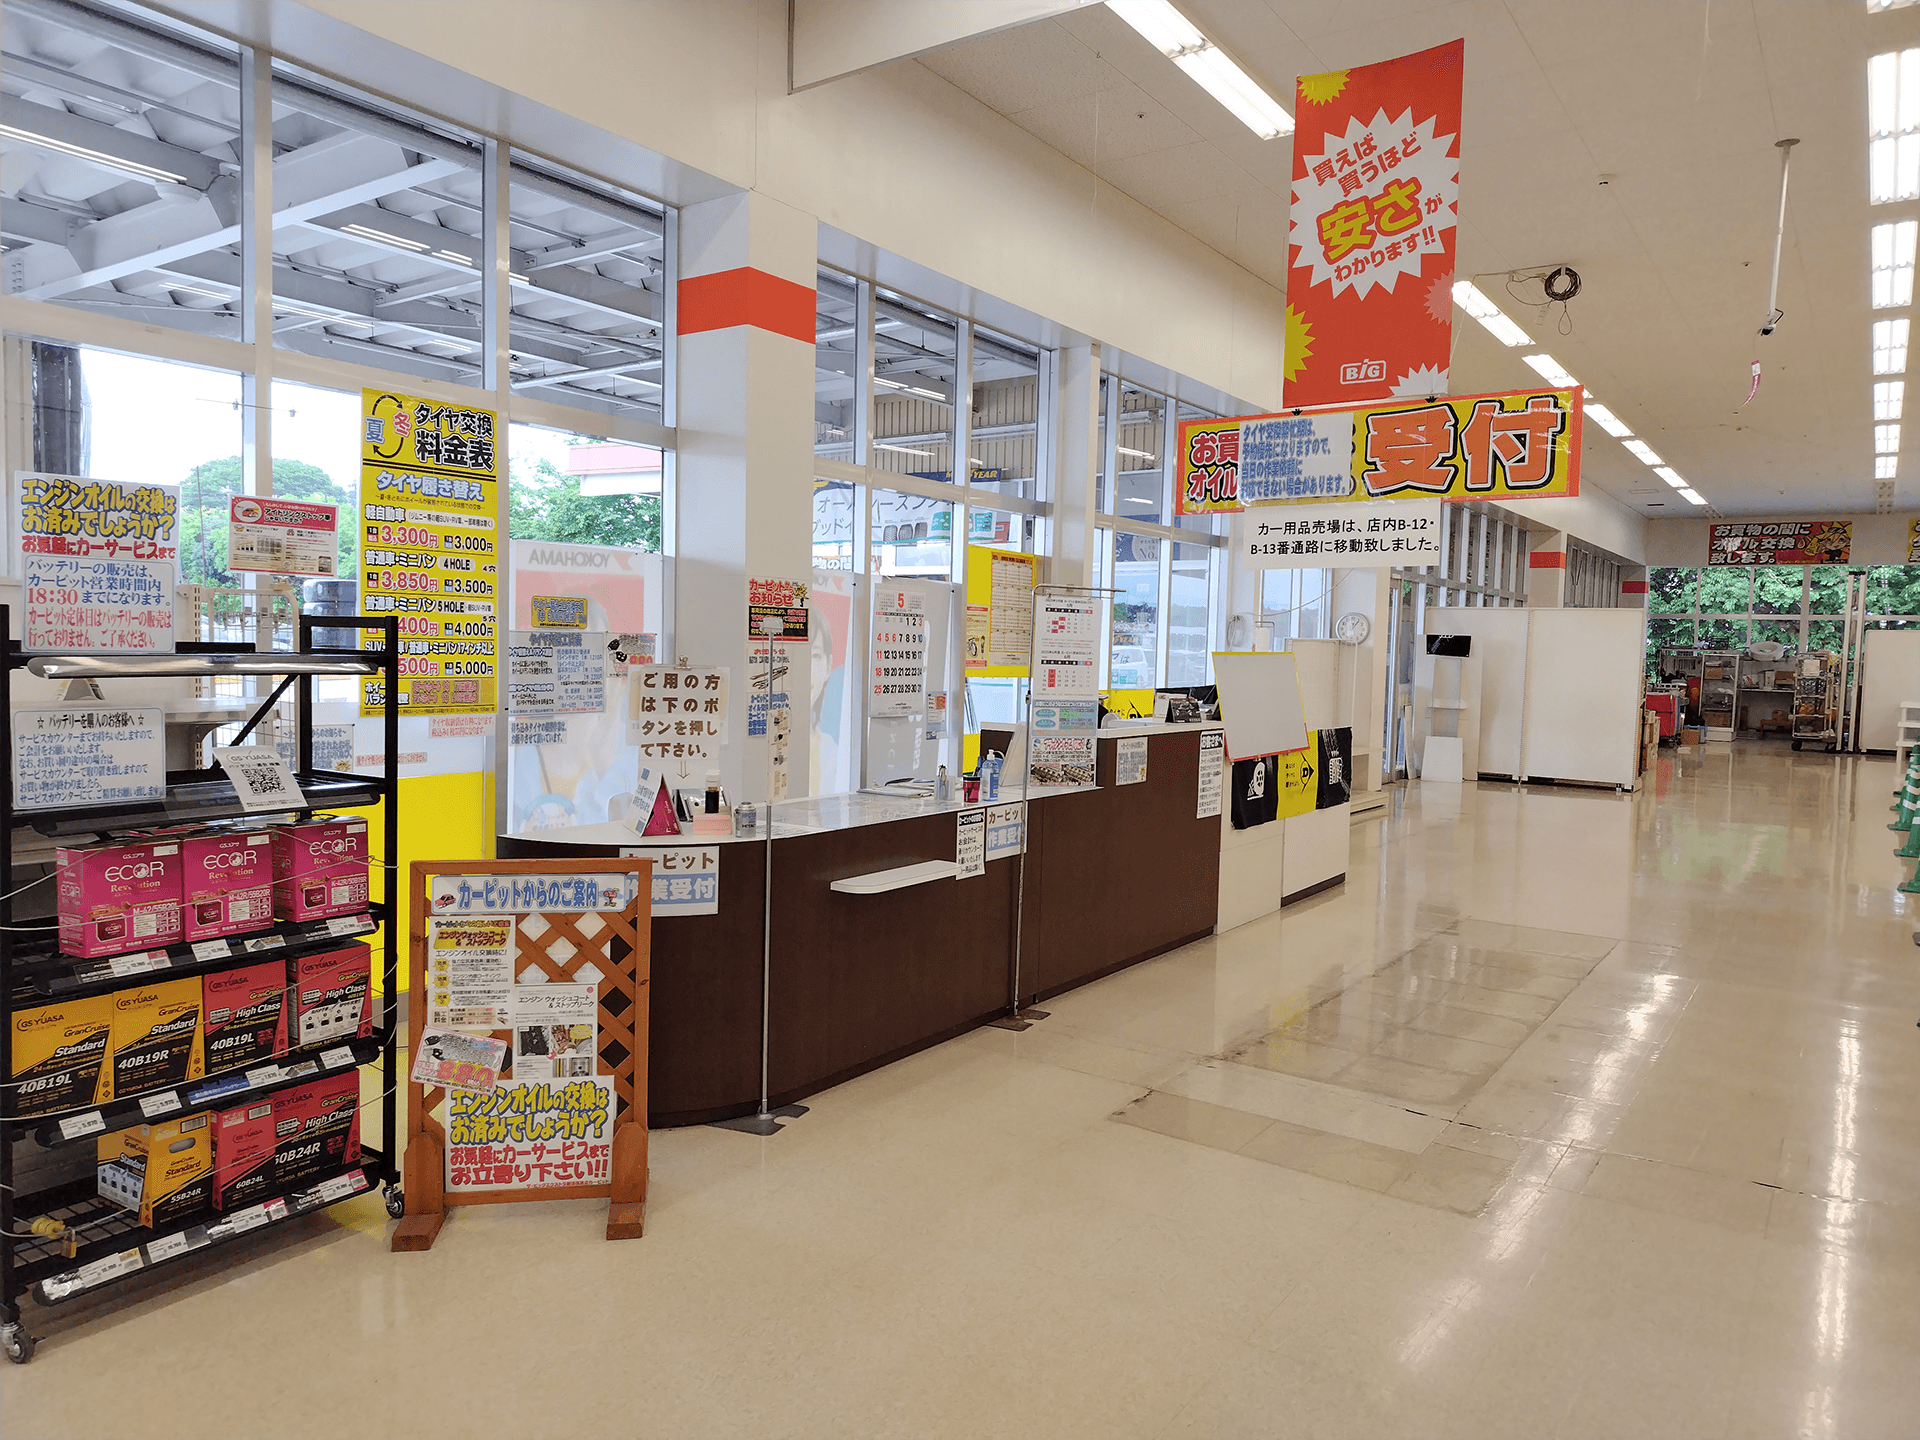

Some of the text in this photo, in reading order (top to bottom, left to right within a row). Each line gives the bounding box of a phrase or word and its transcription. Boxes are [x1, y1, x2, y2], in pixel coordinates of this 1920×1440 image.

[1312, 132, 1378, 187] 買えば
[1338, 131, 1422, 197] 買うほど
[1334, 225, 1436, 283] わかります!!
[393, 411, 412, 438] 冬
[414, 402, 494, 438] タイヤ交換
[365, 416, 385, 444] 夏
[414, 428, 495, 472] 料金表
[1242, 437, 1331, 460] 予約優先になりますので、
[1363, 395, 1565, 497] 受付
[376, 470, 485, 502] タイヤ履き替え
[1188, 467, 1239, 502] オイル
[21, 479, 176, 514] エンジンオイルの交換は
[365, 504, 406, 523] 軽自動車
[381, 525, 493, 552] 3,300円 3,000円
[1713, 523, 1812, 537] お買物の間に
[22, 535, 176, 559] お気軽にカーサービスまで
[1250, 537, 1440, 555] B-13番通路に移動致しました。
[365, 549, 436, 568] 普通車・ミニバン
[450, 559, 471, 570] HOLE
[1710, 551, 1777, 564] 致します。
[28, 559, 153, 578] バッテリーの販売は、
[28, 573, 161, 592] カーピット営業時間内
[381, 571, 493, 595] 3,850円 3,500円
[27, 587, 170, 607] 18:30 までになります。
[365, 595, 436, 612] 普通車・ミニバン
[444, 601, 465, 613] HOLE
[749, 591, 794, 606] お知らせ
[897, 593, 904, 608] 5
[28, 606, 172, 629] カーピット定休日はバッテリーの販売は
[906, 618, 922, 627] 1 2 3
[454, 622, 493, 637] 4,000円
[876, 633, 916, 643] 4 5 6 7 8 9
[876, 651, 917, 660] 11 12 13 14 15 16
[454, 661, 493, 675] 5,000円
[875, 667, 917, 676] 18 19 20 21 22 23
[643, 673, 721, 690] ご用の方
[874, 685, 917, 694] 25 26 27 28 29 30
[641, 697, 719, 714] は下のボ
[641, 720, 718, 736] タンを押し
[641, 743, 707, 759] て下さい。
[988, 807, 1021, 824] カーピッ
[458, 877, 599, 909] カーピットからのご案内
[465, 938, 506, 947] ストップリーク
[326, 984, 367, 999] High Class
[544, 995, 590, 1003] ウォッシュコート
[158, 1004, 200, 1017] GranCruise
[236, 1003, 281, 1018] High Class
[555, 1001, 594, 1009] ストップリーク
[64, 1023, 110, 1038] GranCruise
[150, 1018, 196, 1035] Standard
[54, 1039, 105, 1057] Standard
[210, 1033, 254, 1050] 40B19L
[118, 1050, 169, 1070] 40B19R
[17, 1074, 72, 1094] 40B19L
[305, 1109, 354, 1128] High Class
[450, 1141, 610, 1166] お気軽にカーサービスまで
[165, 1161, 201, 1177] Standard
[450, 1158, 608, 1186] お立寄り下さい!!
[235, 1175, 264, 1189] 60B24L
[171, 1187, 202, 1204] 55B24R
